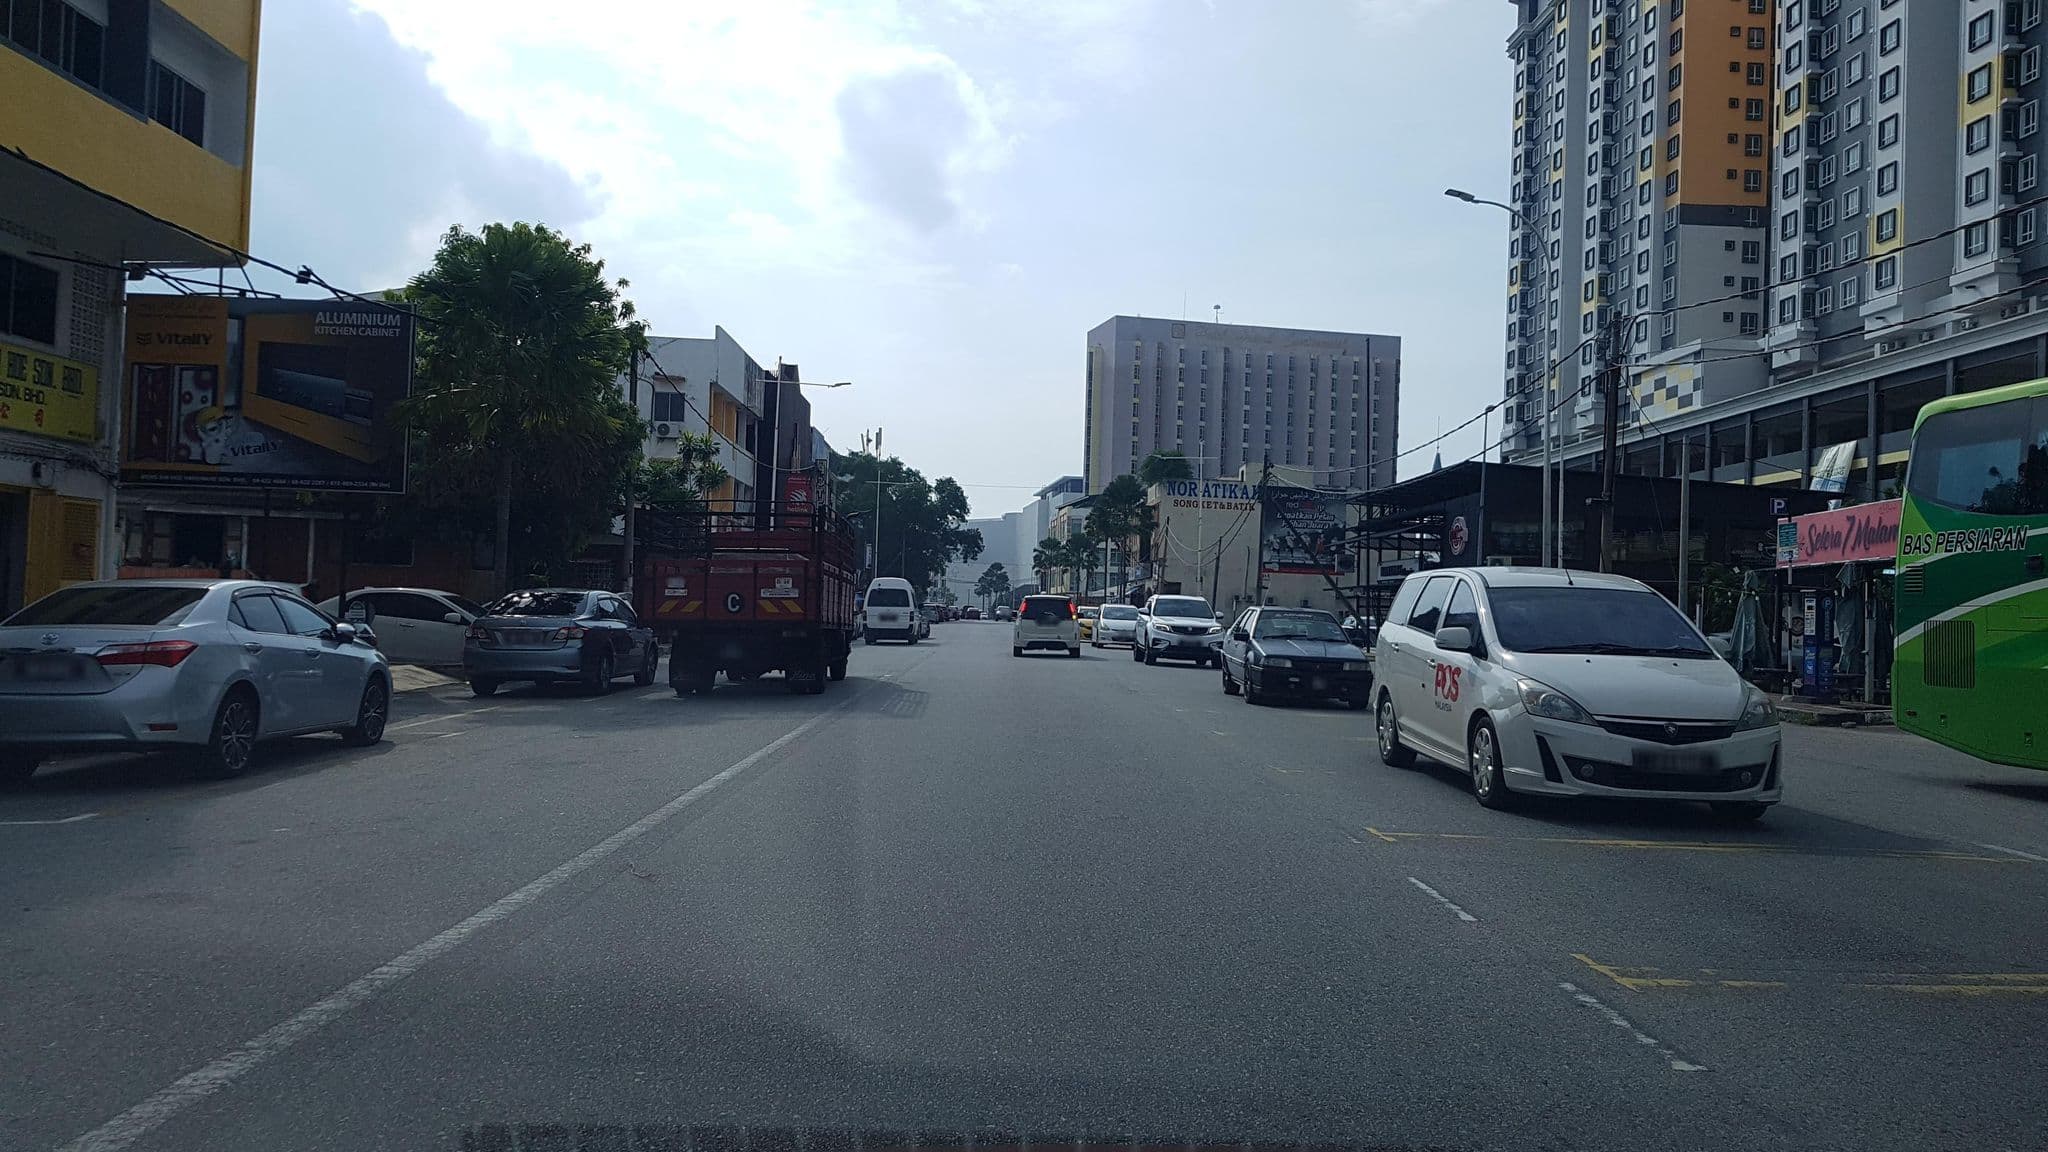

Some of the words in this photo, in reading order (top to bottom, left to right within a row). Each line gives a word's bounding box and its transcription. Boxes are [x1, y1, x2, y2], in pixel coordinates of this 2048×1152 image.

[315, 312, 401, 327] ALUMINIUM
[314, 326, 357, 336] KITCHEN
[358, 327, 401, 337] CABINET
[1773, 499, 1786, 514] P
[1841, 514, 1856, 556] 7
[1902, 532, 1932, 556] BAS
[1934, 524, 2029, 554] PERSIARAN
[727, 593, 740, 613] C
[1435, 662, 1462, 702] POS
